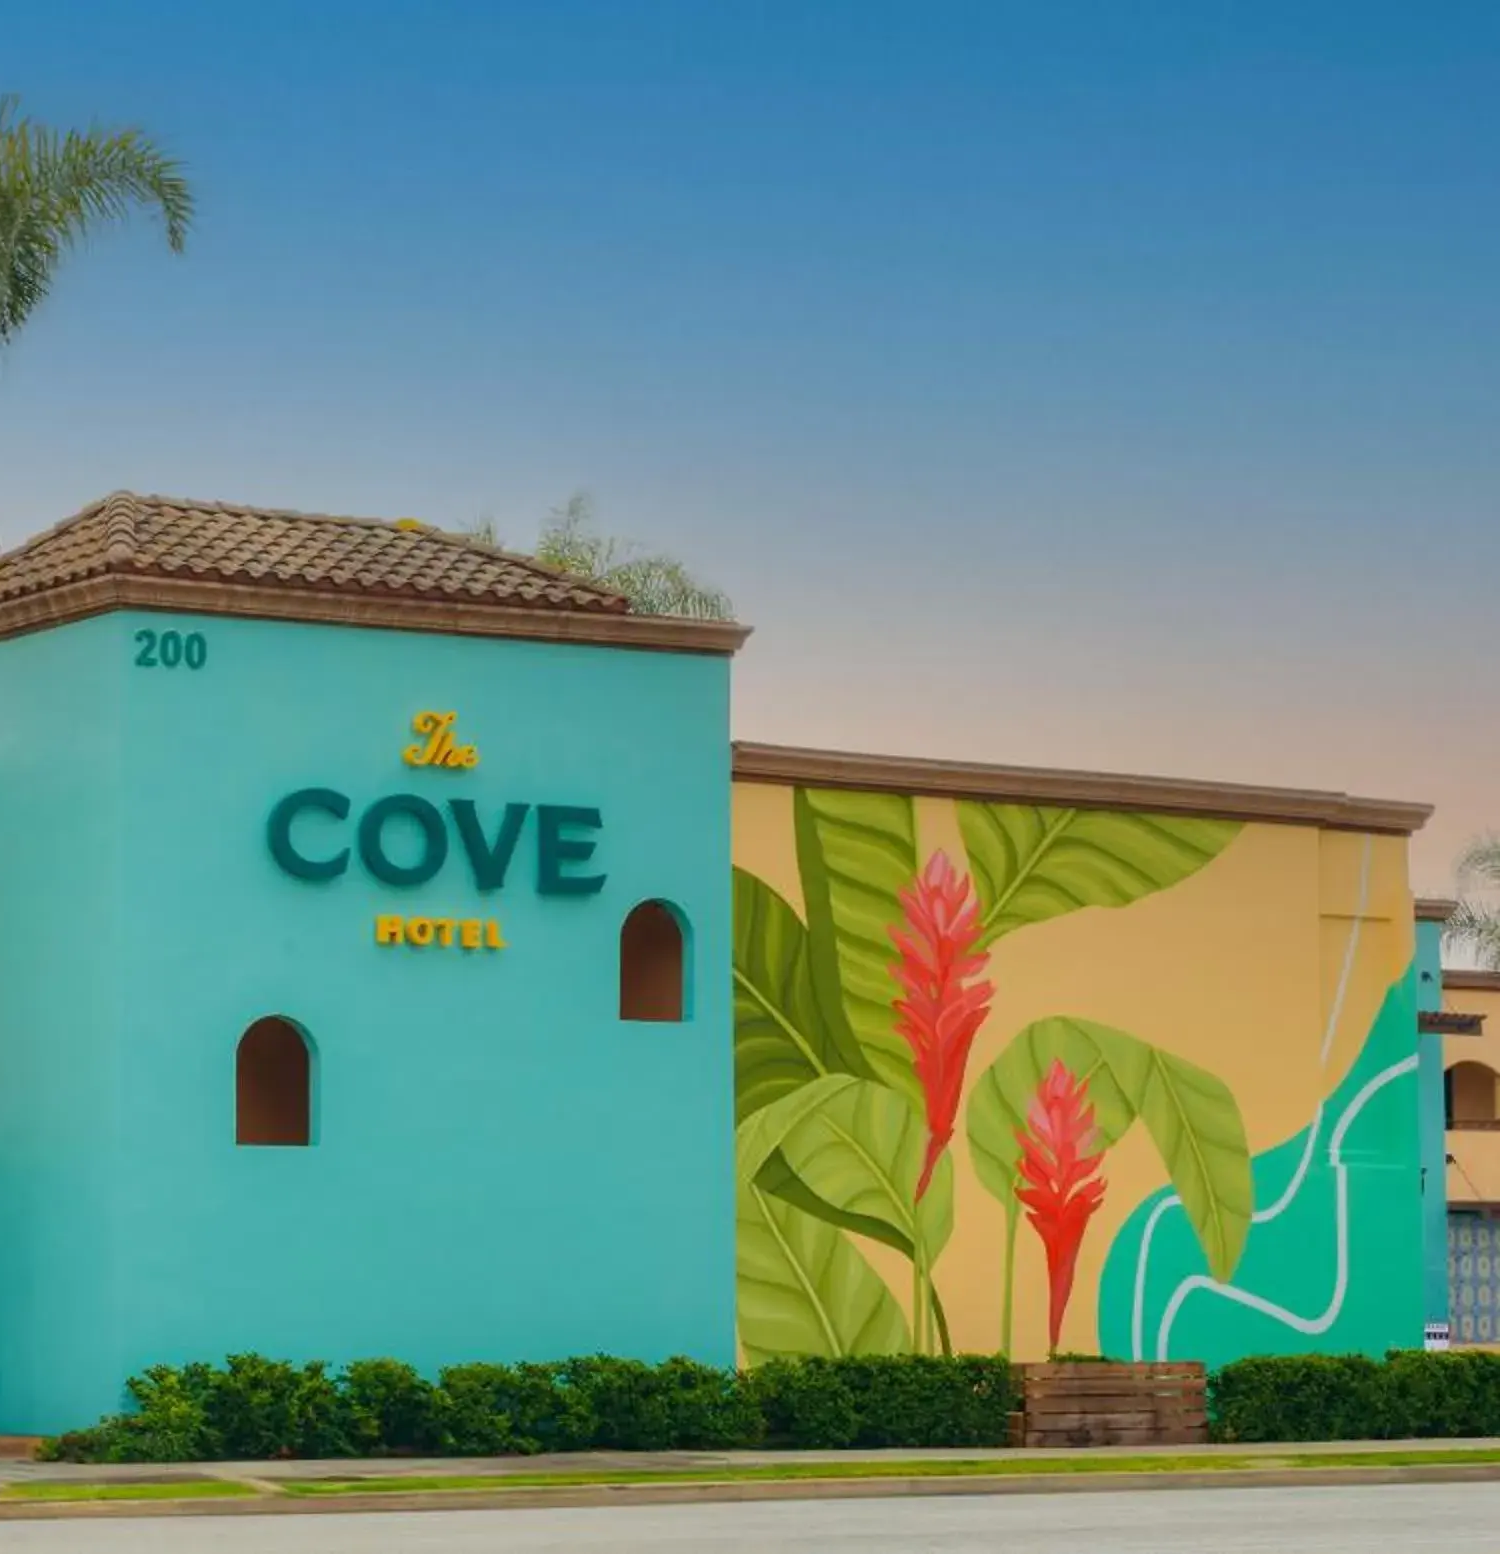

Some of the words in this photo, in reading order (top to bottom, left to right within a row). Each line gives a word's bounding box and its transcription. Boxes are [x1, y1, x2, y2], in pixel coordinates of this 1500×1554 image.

[134, 629, 207, 669] 200
[403, 710, 480, 768] The
[267, 787, 607, 896] COVE
[375, 914, 506, 949] HOTEL
